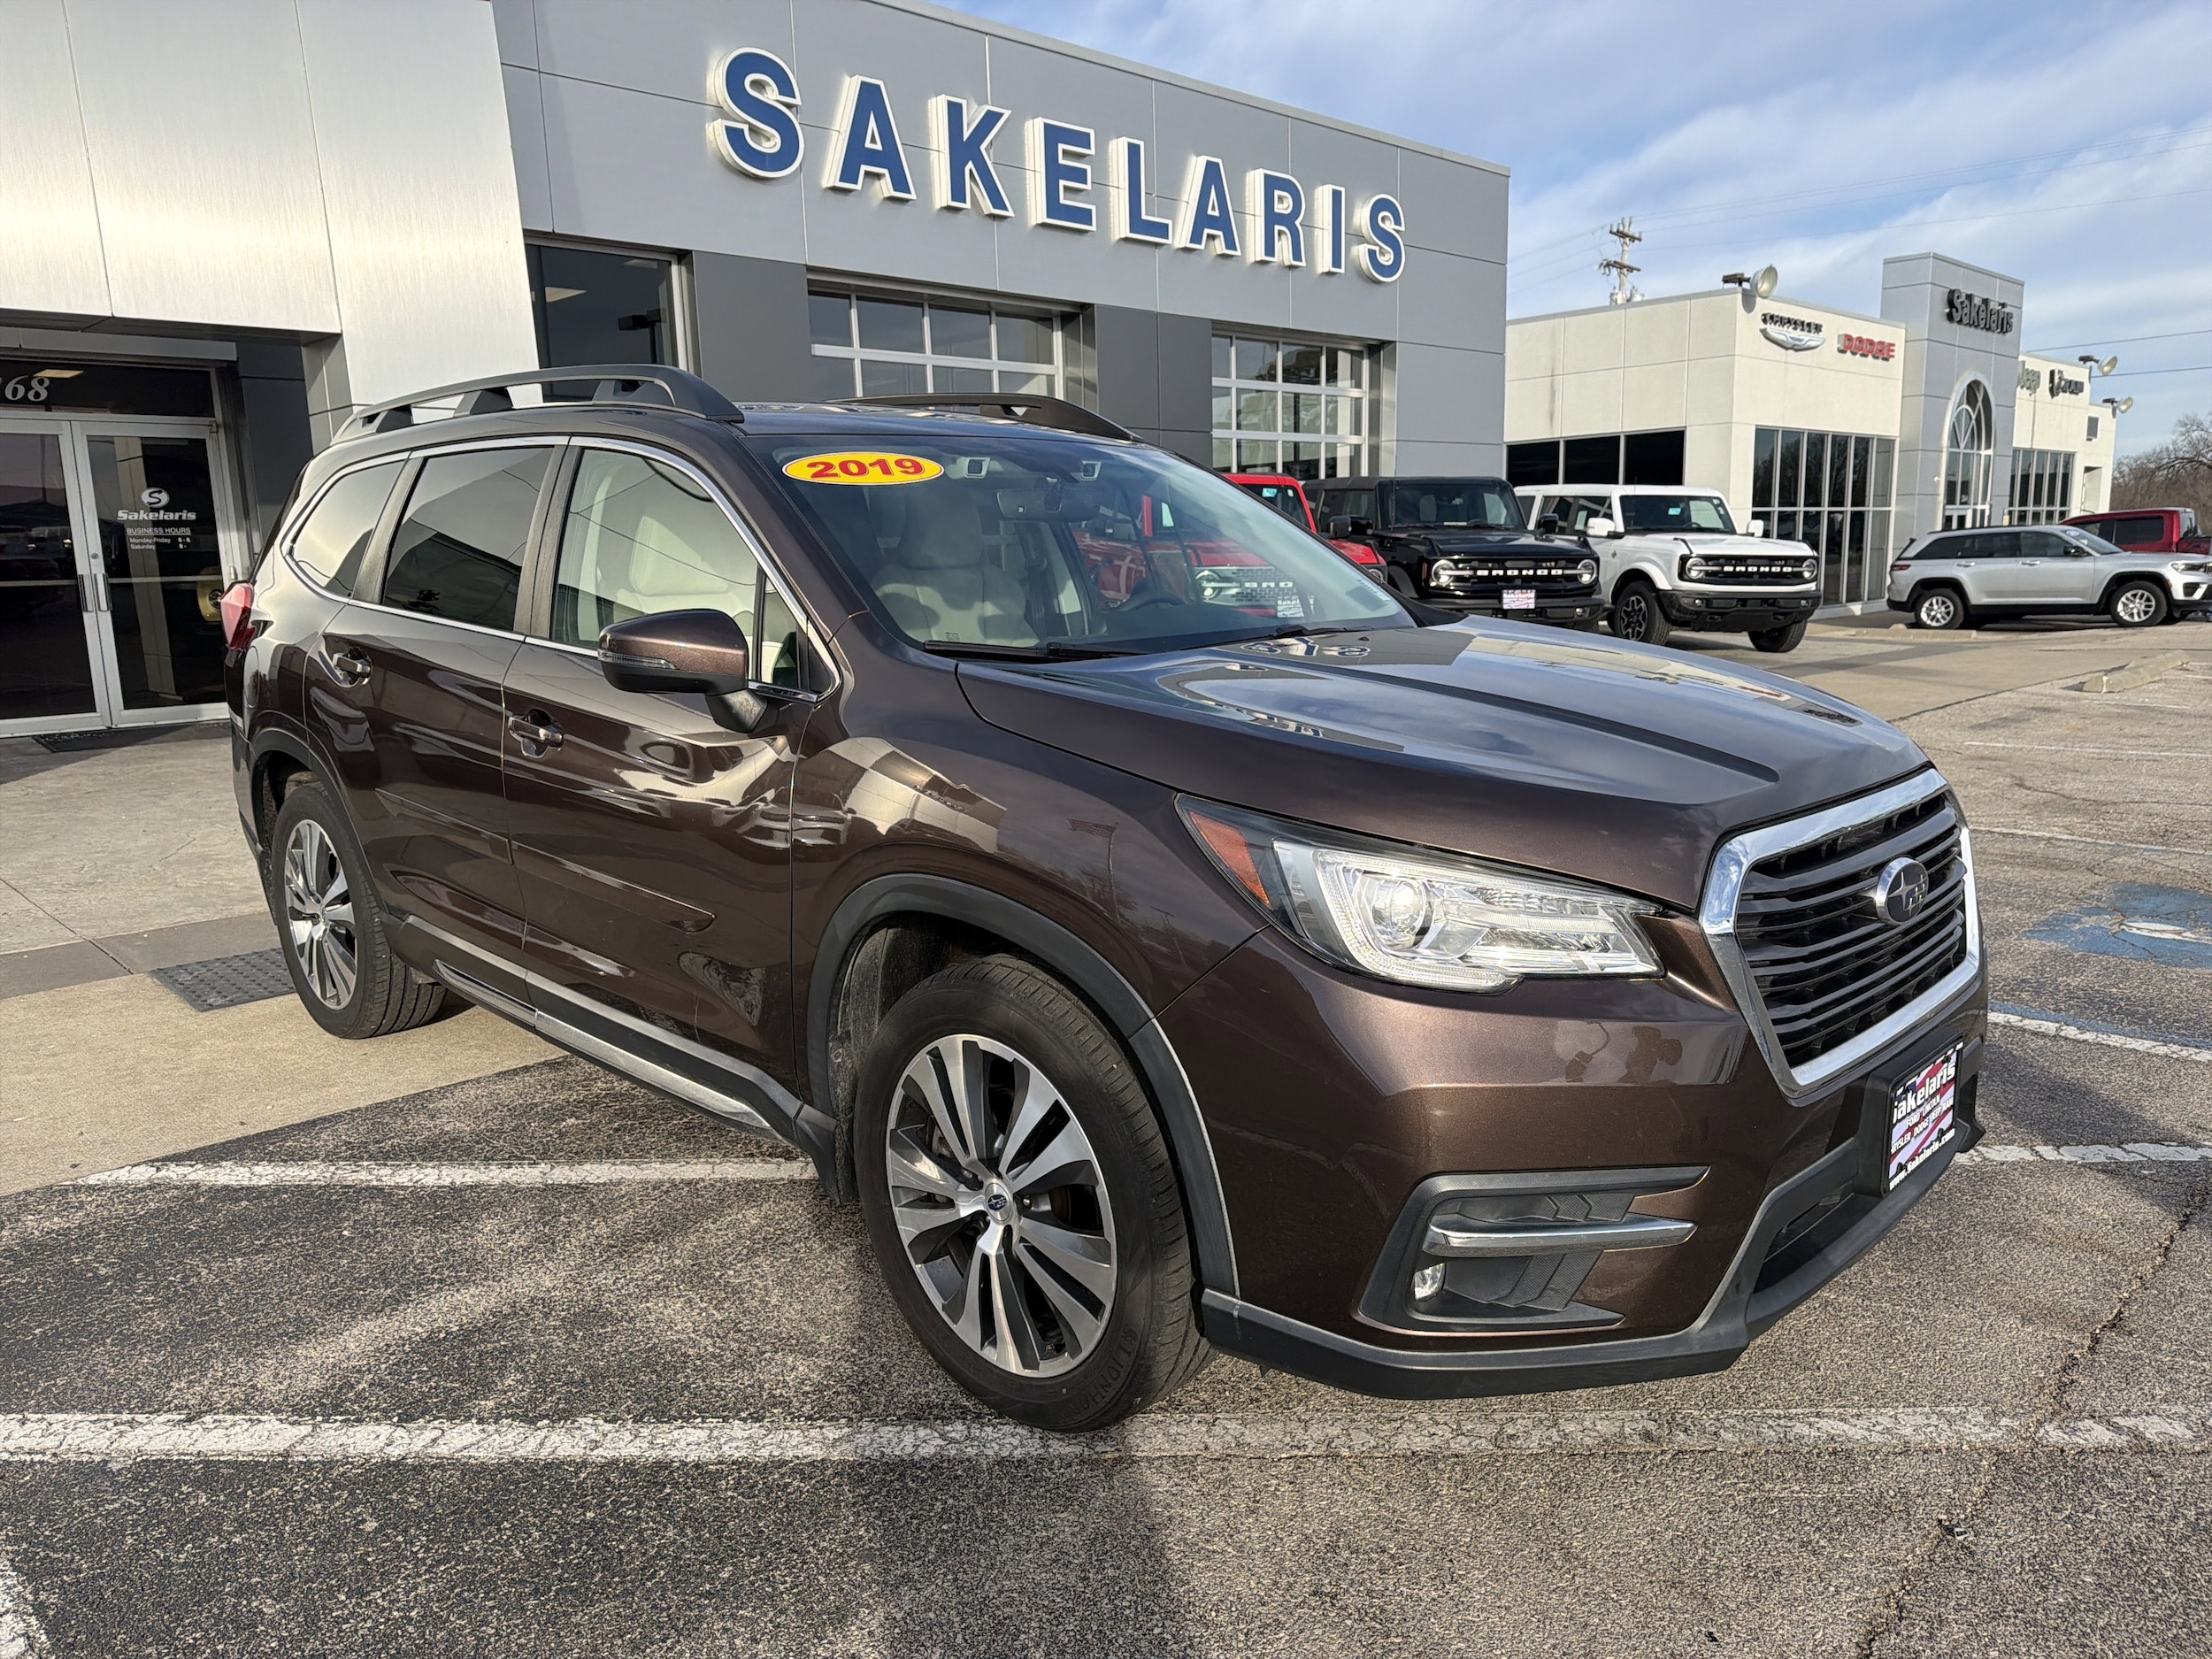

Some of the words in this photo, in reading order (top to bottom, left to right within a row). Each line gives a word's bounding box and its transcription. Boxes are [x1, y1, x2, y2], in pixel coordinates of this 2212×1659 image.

[710, 47, 1406, 283] SAKELARIS
[1949, 288, 2014, 334] Sakelaris
[1842, 334, 1896, 359] DODGE
[0, 375, 50, 402] 68
[807, 458, 925, 479] 2019
[117, 510, 196, 520] Sakelaris
[1907, 1111, 1920, 1128] FORD
[1922, 1094, 1941, 1117] LINCOLN
[1914, 1117, 1929, 1137] DODGE
